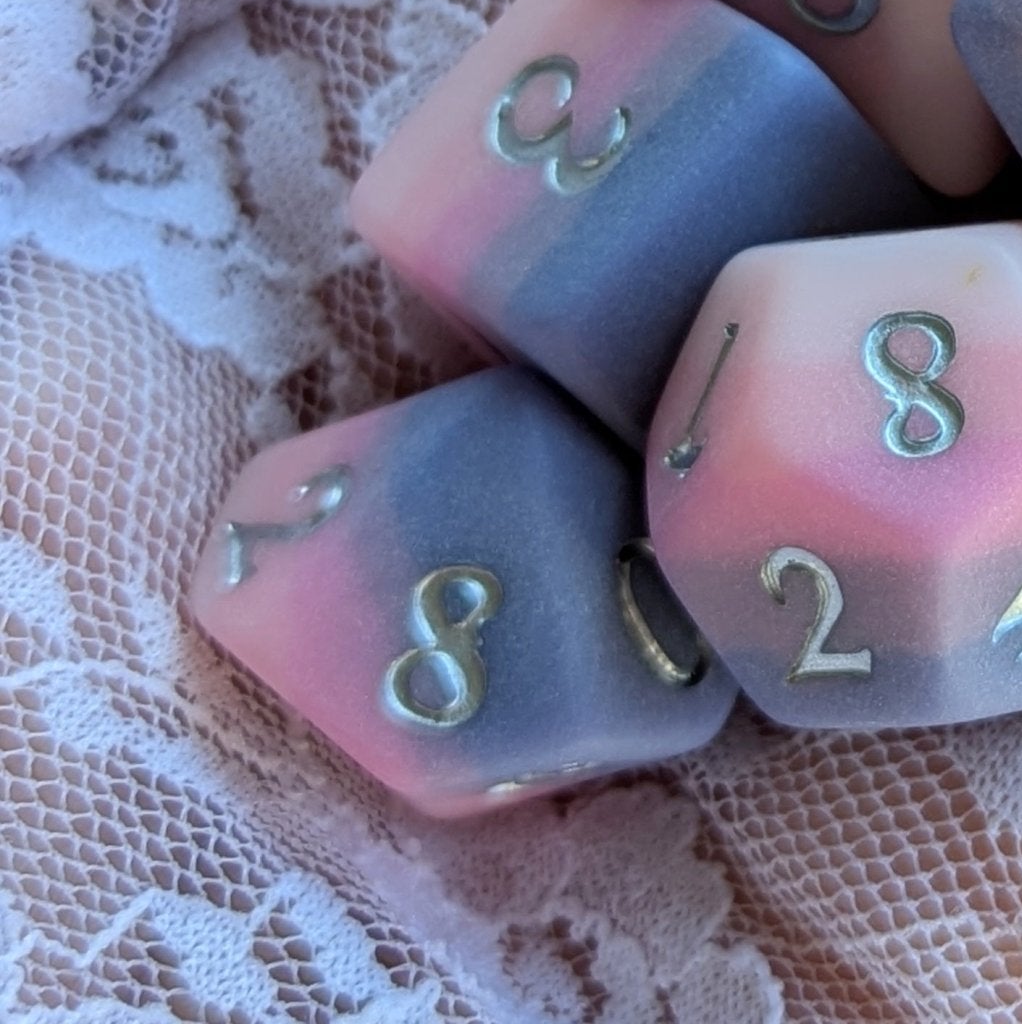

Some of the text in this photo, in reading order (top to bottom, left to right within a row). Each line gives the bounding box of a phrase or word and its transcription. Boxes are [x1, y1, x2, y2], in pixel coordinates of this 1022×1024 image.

[486, 51, 631, 198] 3
[864, 309, 966, 459] 8
[382, 563, 502, 728] 8
[760, 546, 873, 684] 2
